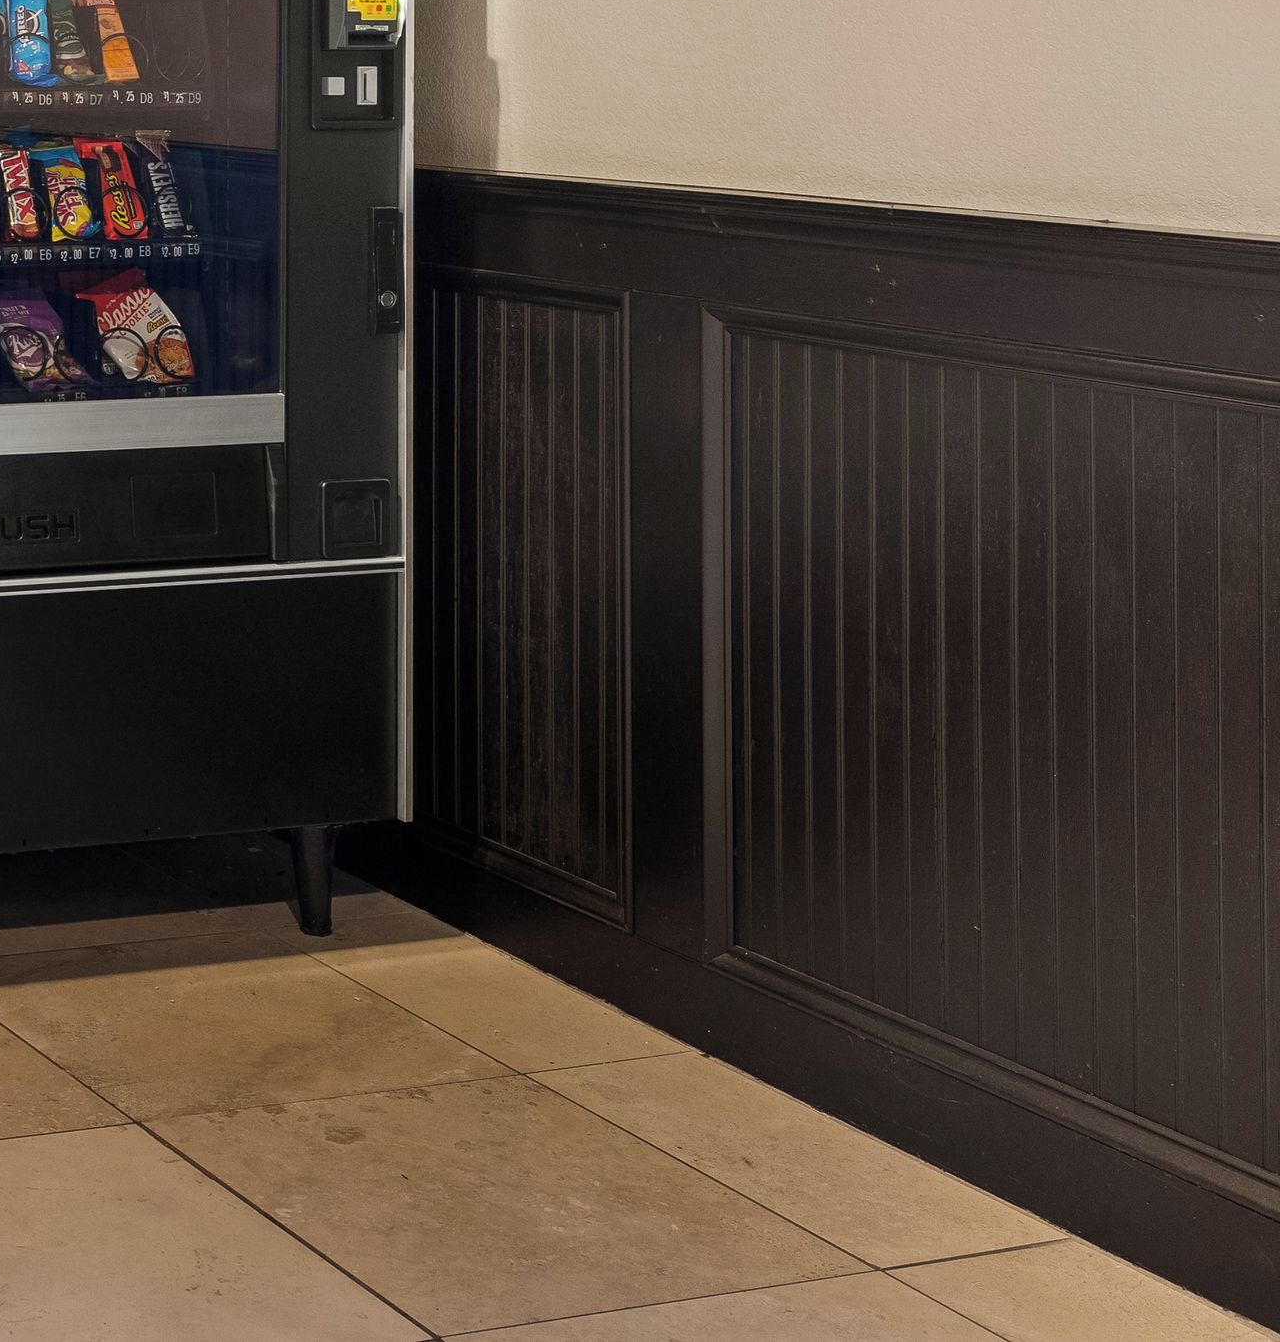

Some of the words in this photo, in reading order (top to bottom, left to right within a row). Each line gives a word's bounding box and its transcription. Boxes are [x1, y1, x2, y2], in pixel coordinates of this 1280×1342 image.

[38, 93, 53, 106] D6
[89, 93, 104, 106] D7
[139, 92, 154, 104] D8
[187, 92, 202, 104] D9
[2, 151, 37, 225] TWIX
[105, 172, 131, 230] Reese's
[11, 249, 33, 264] $2.00
[40, 249, 52, 261] E6
[60, 249, 82, 262] $2.00
[89, 247, 101, 259] E7
[109, 247, 133, 260] $2.00
[139, 246, 151, 257] E8
[161, 246, 183, 257] $2.00
[187, 243, 200, 255] E9
